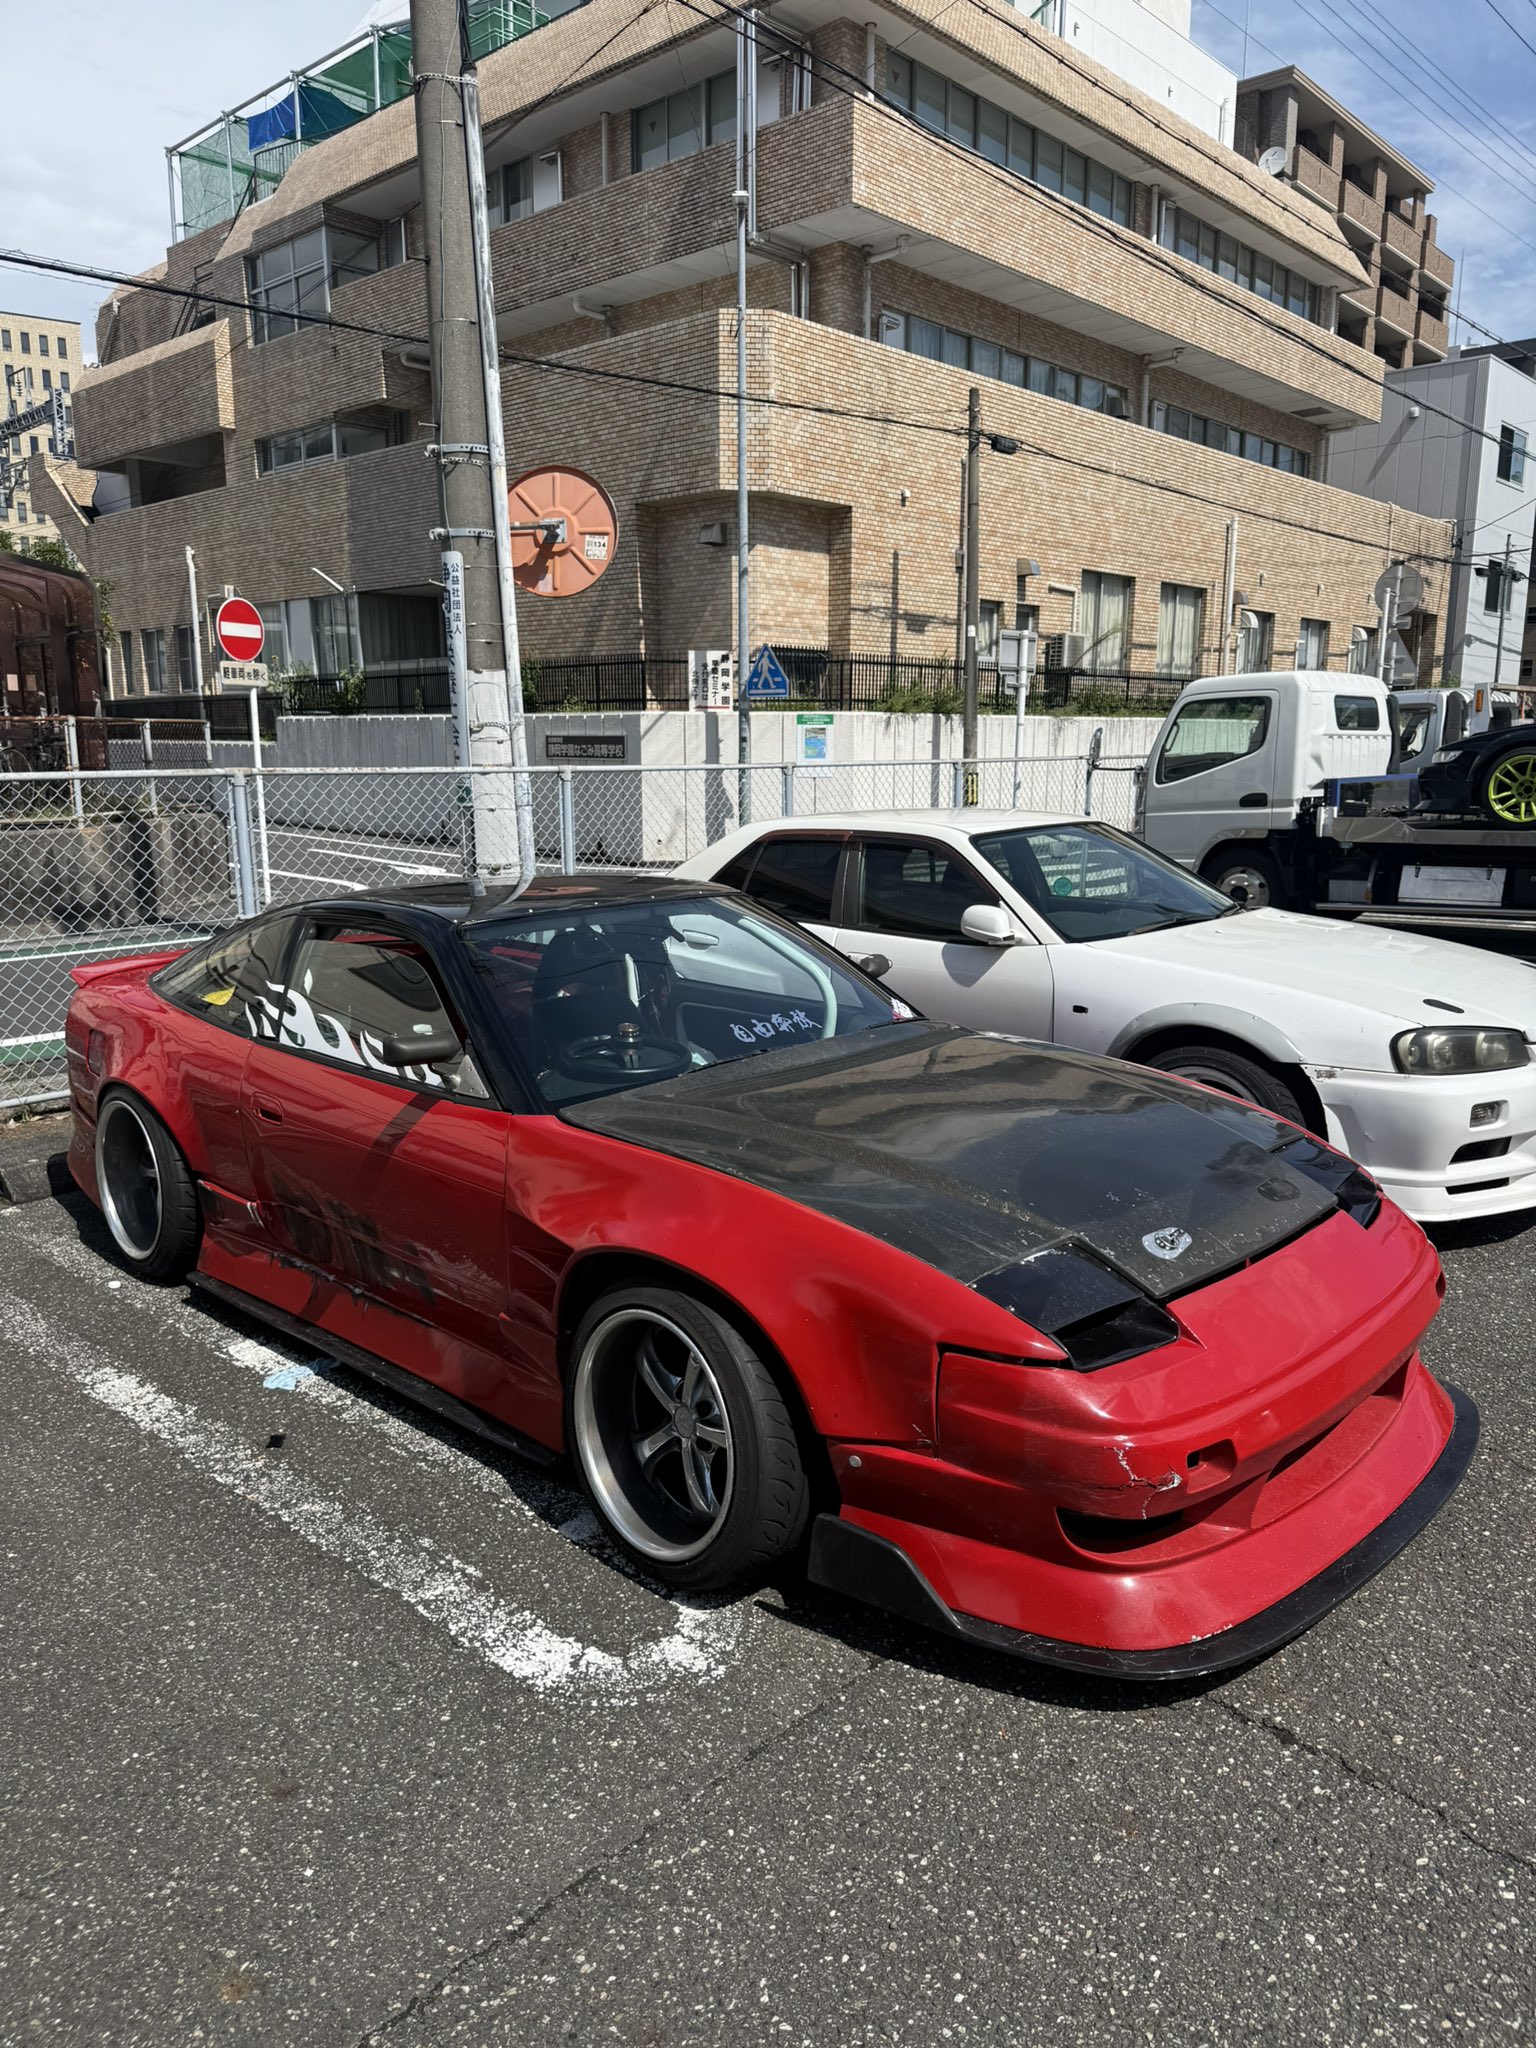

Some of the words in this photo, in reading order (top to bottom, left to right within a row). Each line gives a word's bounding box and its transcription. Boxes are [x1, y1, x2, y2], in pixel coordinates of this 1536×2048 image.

[450, 563, 462, 635] 公益社団法人
[720, 653, 731, 706] 静岡学園
